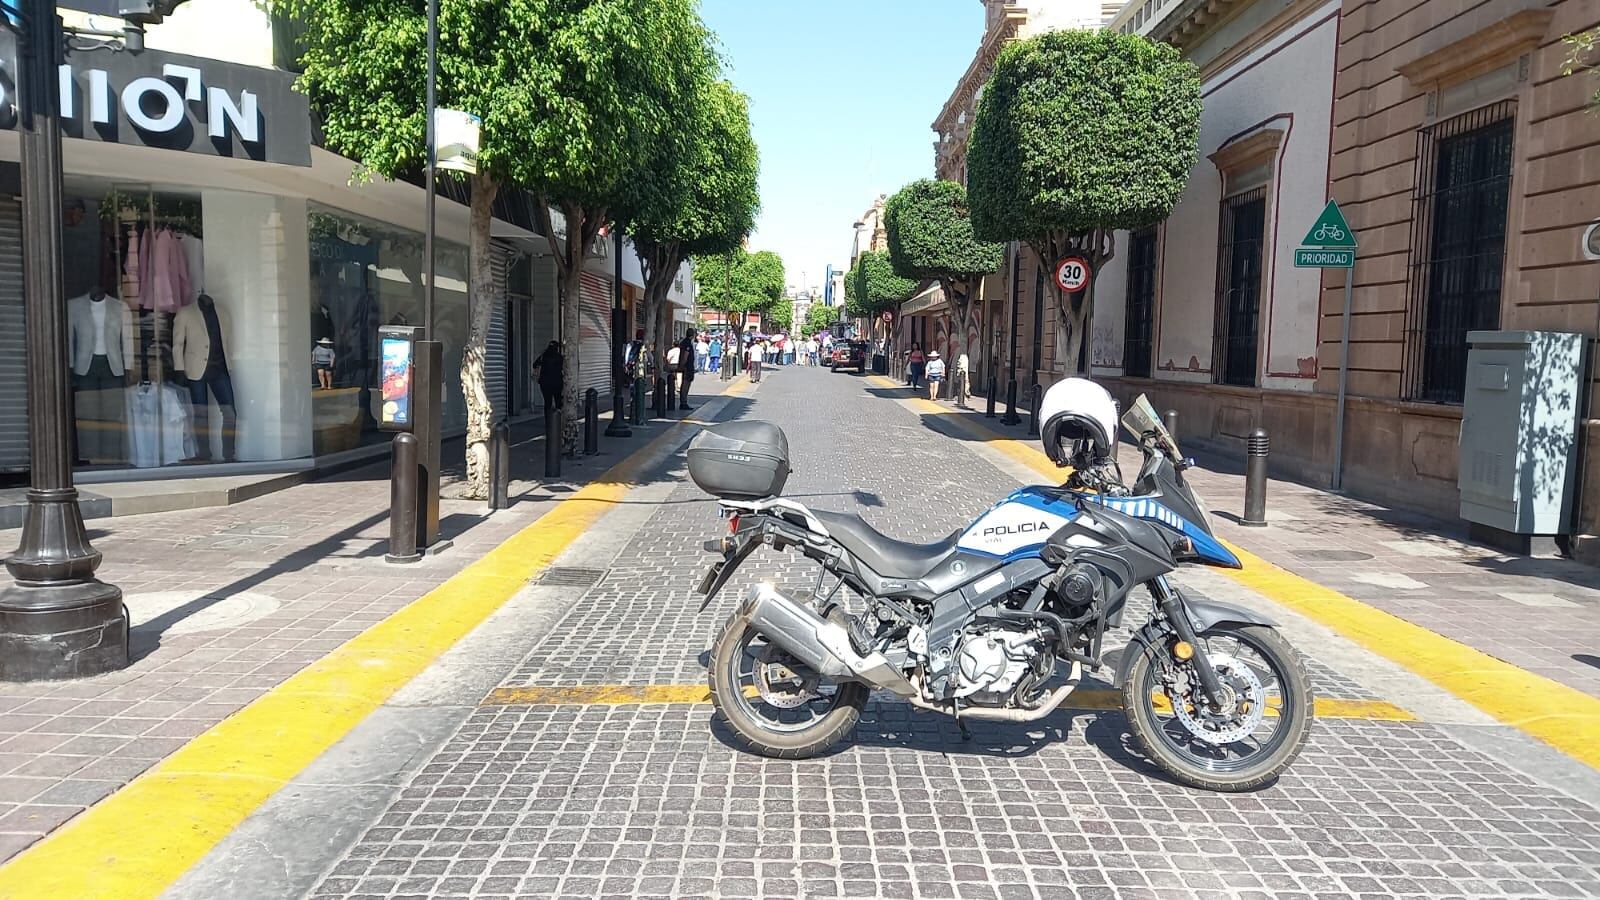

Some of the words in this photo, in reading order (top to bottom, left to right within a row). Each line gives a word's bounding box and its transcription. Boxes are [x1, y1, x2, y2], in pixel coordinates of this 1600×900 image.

[1301, 253, 1348, 264] PRIORIDAD
[1063, 264, 1082, 280] 30
[983, 521, 1050, 536] POLICIA
